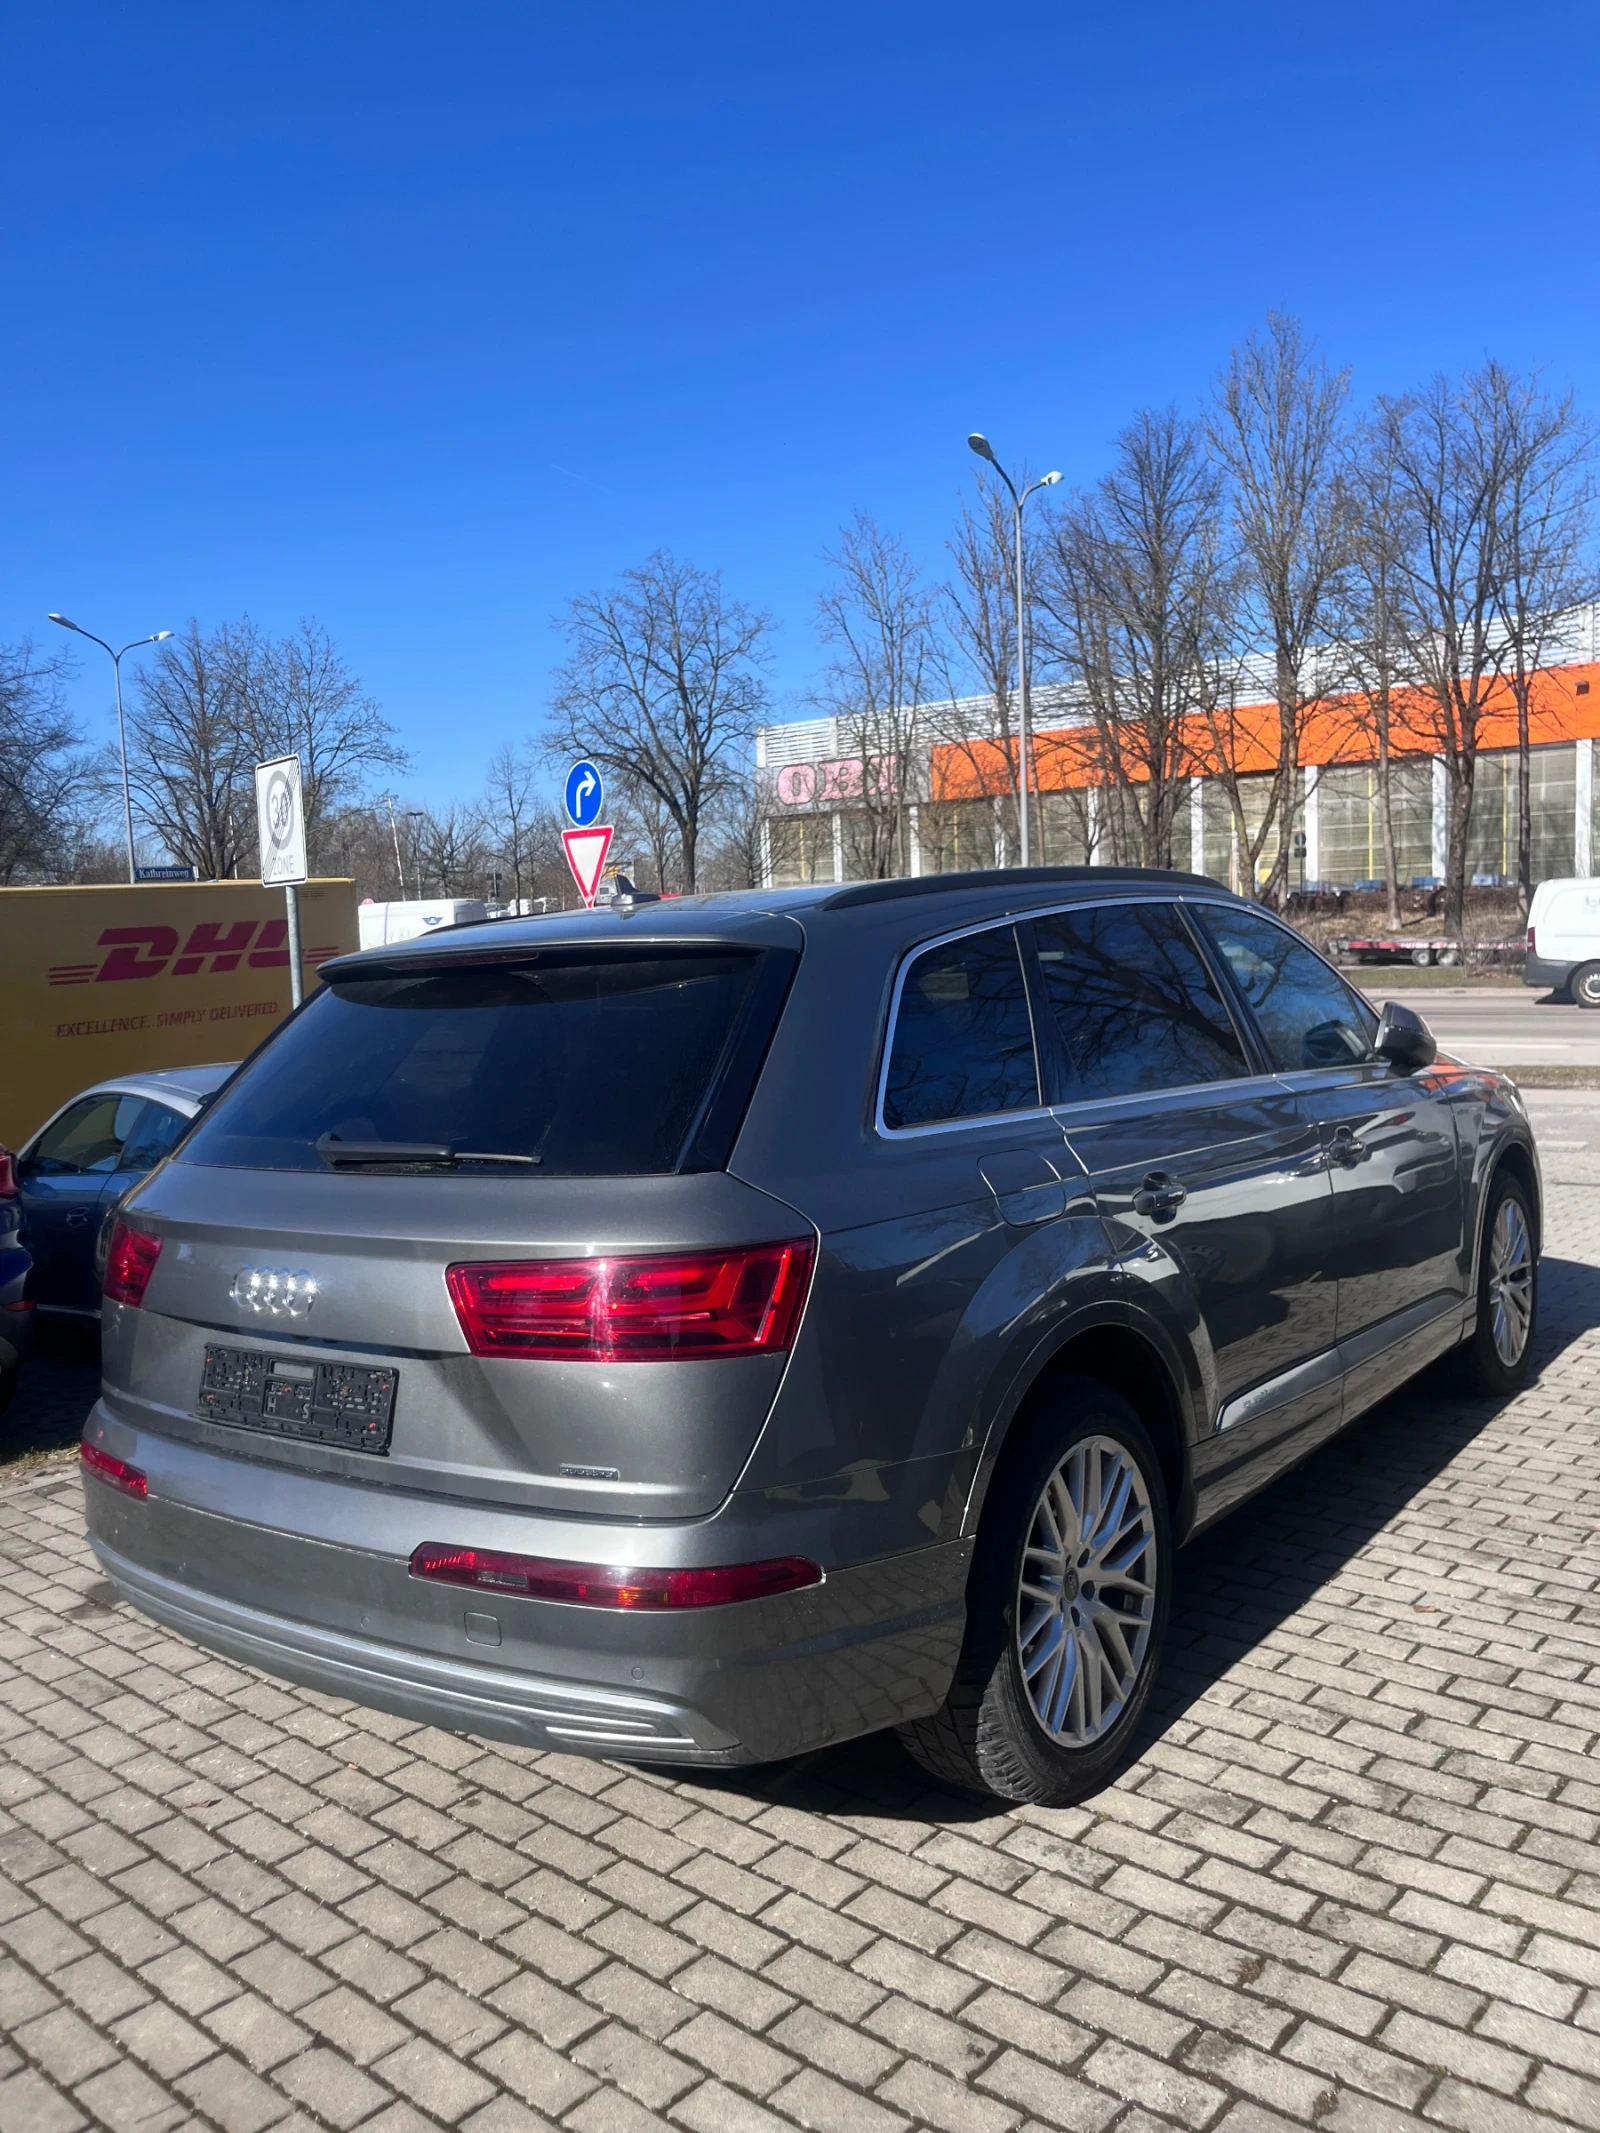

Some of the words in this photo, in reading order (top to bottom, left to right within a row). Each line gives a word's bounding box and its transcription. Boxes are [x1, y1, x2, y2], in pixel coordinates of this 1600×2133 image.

[777, 756, 897, 804] OBI
[271, 791, 288, 829] 30
[139, 869, 189, 878] Kathreinweg
[273, 855, 295, 876] ZONE
[95, 919, 304, 982] DHL
[56, 1015, 151, 1038] EXCELLENCE.
[157, 1009, 207, 1028] SIMPLY
[210, 1001, 281, 1021] DELIVERED.
